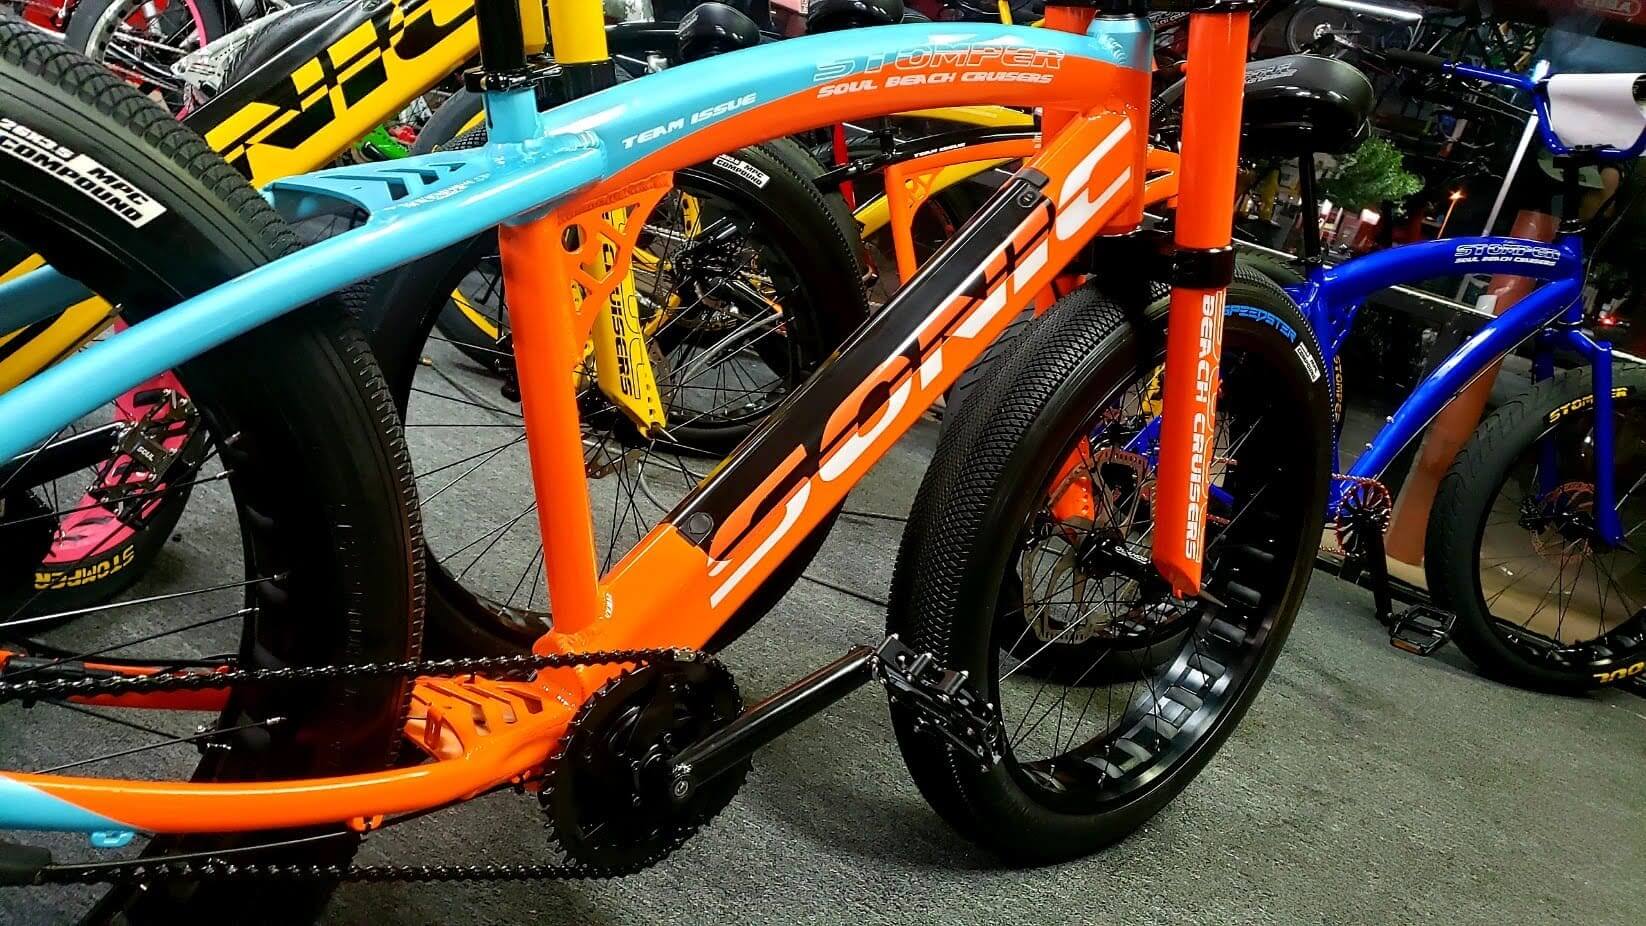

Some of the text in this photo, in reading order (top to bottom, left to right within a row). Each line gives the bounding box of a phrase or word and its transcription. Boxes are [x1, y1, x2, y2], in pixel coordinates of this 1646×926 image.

[813, 43, 1065, 82] STOMPER
[817, 71, 1054, 99] SOUL BEACH CRUISERS
[621, 92, 758, 150] TEAM ISSUE
[0, 136, 143, 222] COMPOUND
[87, 167, 149, 206] MPC
[716, 159, 762, 186] COMPOUND
[743, 164, 765, 179] MPC
[1454, 243, 1561, 260] STOMPER
[707, 116, 1132, 609] SONIC
[1184, 294, 1216, 561] BEACH CRUISERS
[136, 446, 155, 462] SOUL
[33, 544, 135, 590] STOMPER
